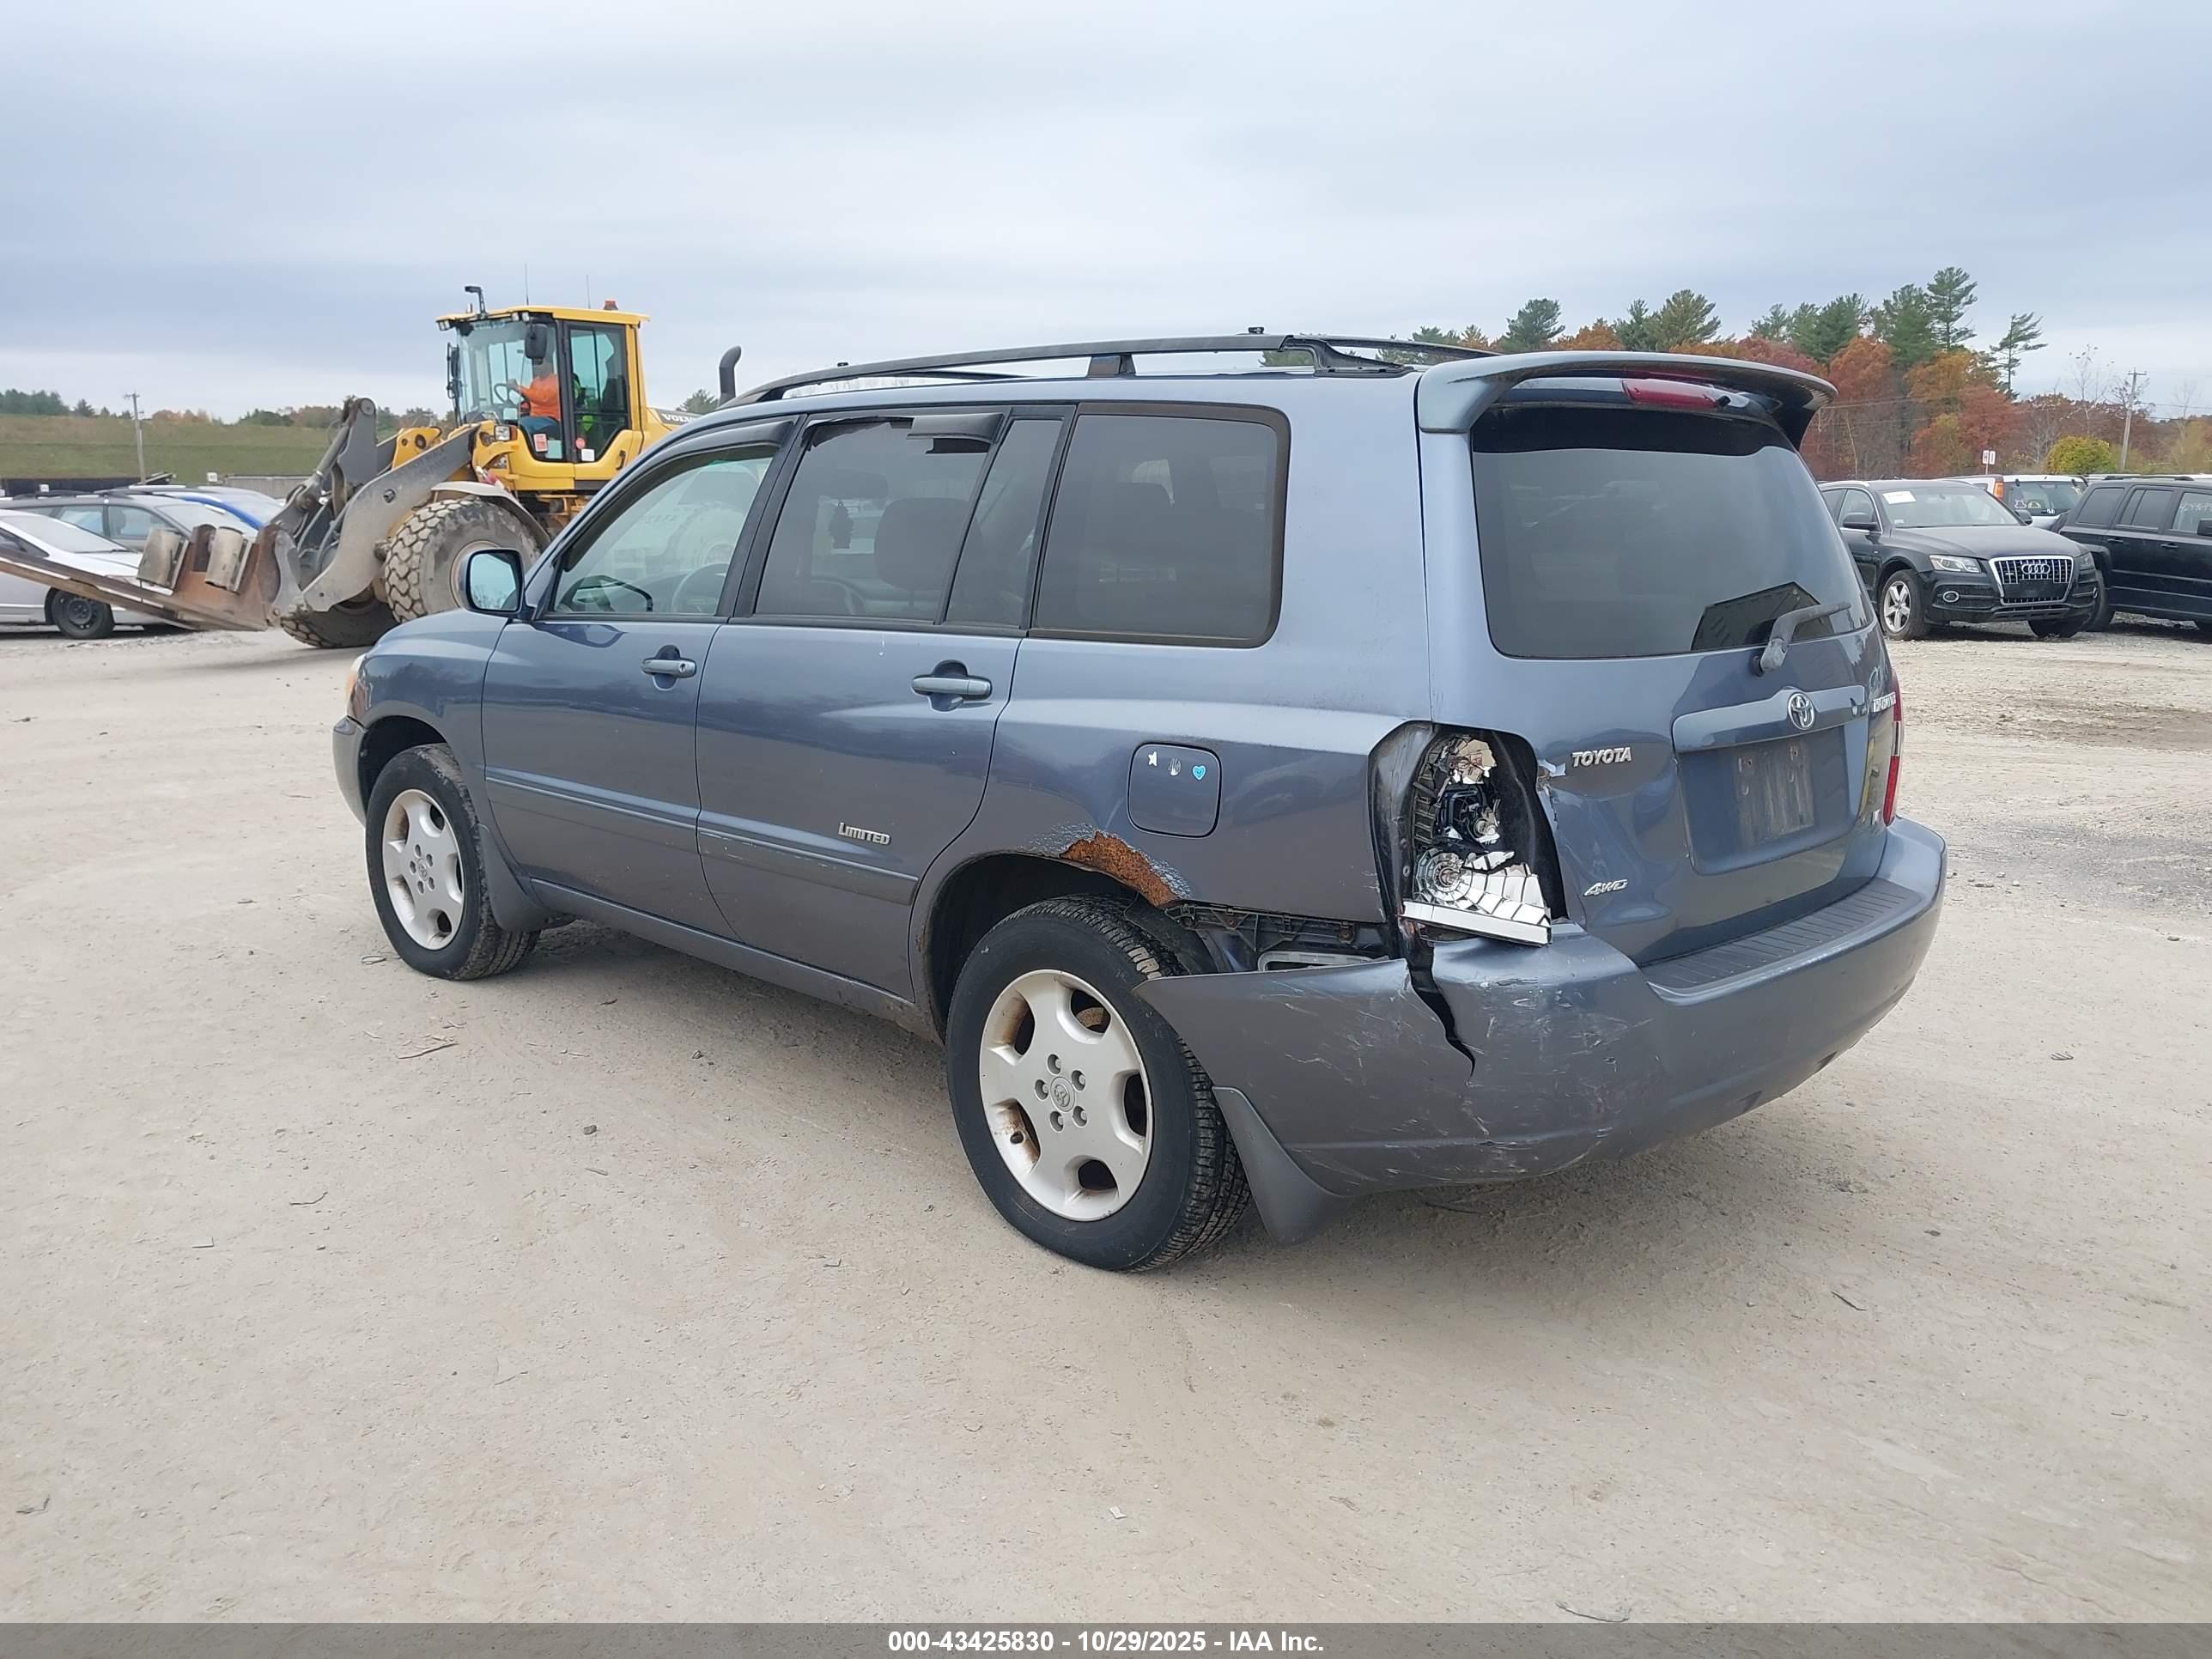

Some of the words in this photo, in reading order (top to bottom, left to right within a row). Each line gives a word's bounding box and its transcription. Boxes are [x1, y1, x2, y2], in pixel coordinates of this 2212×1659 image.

[660, 413, 693, 422] VOLV
[1571, 746, 1632, 768] TOYOTA
[837, 822, 890, 845] LIMITED
[1583, 878, 1628, 896] 4WD
